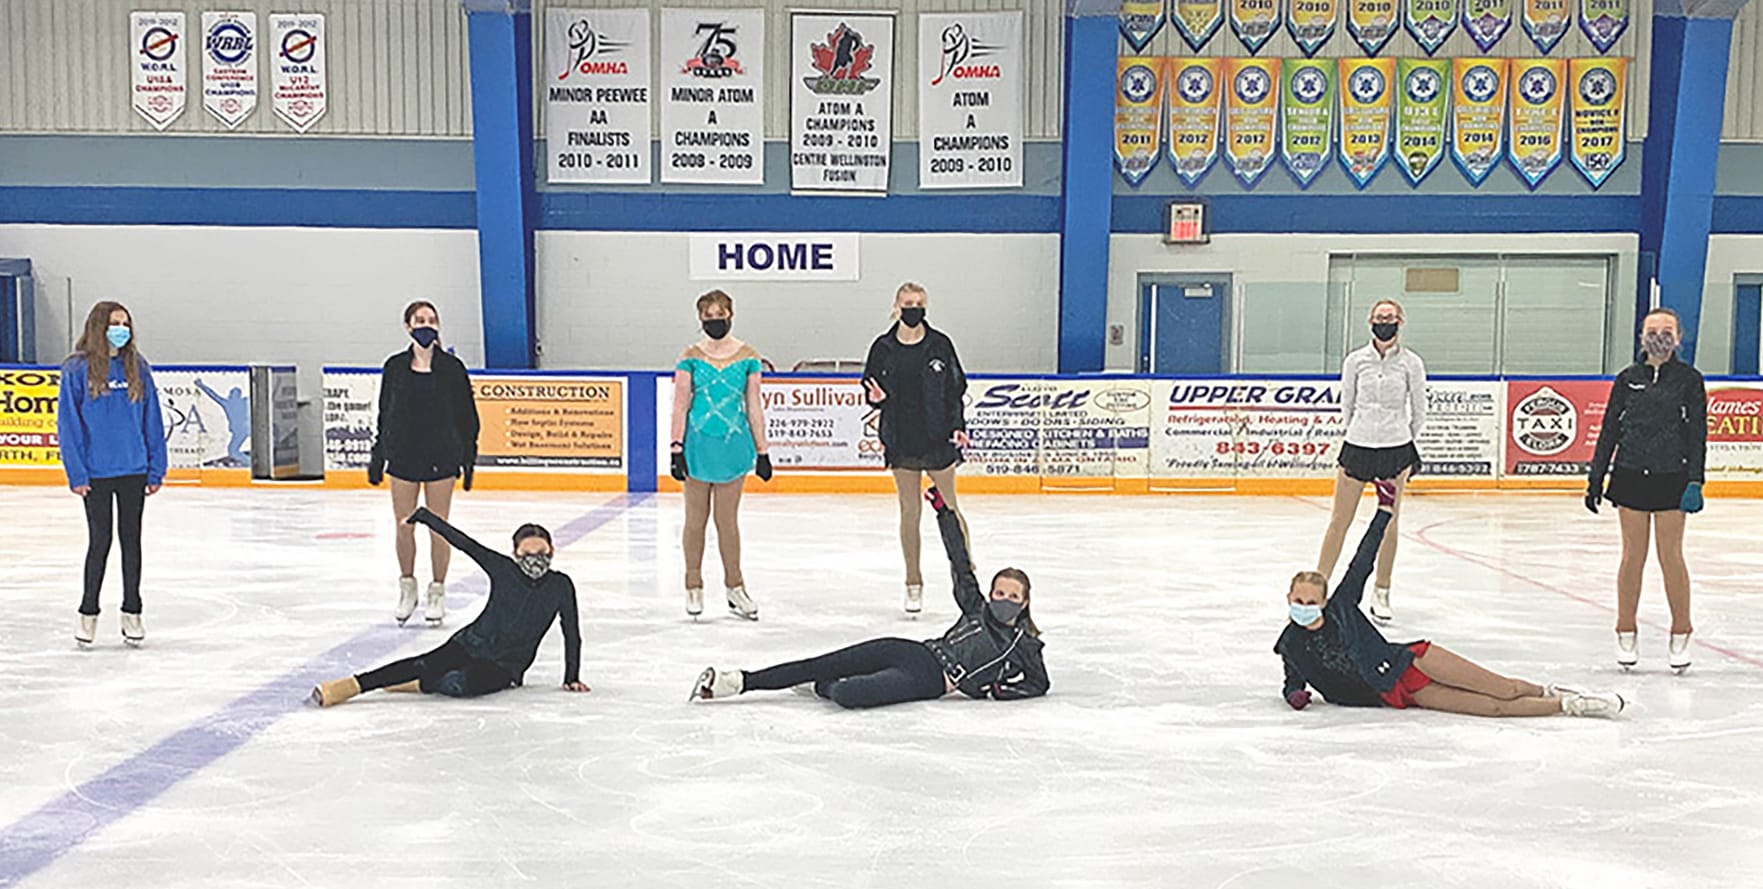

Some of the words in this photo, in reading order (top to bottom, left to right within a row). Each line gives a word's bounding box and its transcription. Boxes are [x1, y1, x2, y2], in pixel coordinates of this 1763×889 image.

[1297, 1, 1330, 12] 2010
[1358, 2, 1391, 12] 2010
[1416, 0, 1450, 11] 2010
[694, 22, 739, 58] 75
[580, 62, 628, 74] OMHA
[953, 66, 1001, 79] OMHA
[550, 87, 592, 102] MINOR
[596, 87, 647, 102] PEEWEE
[671, 87, 714, 102] MINOR
[718, 87, 754, 102] ATOM
[953, 92, 989, 107] ATOM
[817, 102, 851, 115] ATOM
[855, 102, 864, 115] A
[589, 110, 608, 124] AA
[707, 110, 717, 124] A
[966, 114, 976, 129] A
[805, 119, 875, 132] CHAMPIONS
[568, 132, 630, 146] FINALISTS
[675, 132, 750, 147] CHAMPIONS
[802, 134, 833, 147] 2009
[847, 135, 879, 148] 2010
[933, 136, 1009, 150] CHAMPIONS
[1121, 133, 1151, 144] 2011
[1179, 134, 1208, 144] 2012
[1236, 134, 1265, 144] 2012
[1292, 136, 1321, 145] 2012
[1404, 136, 1436, 147] 2014
[1581, 136, 1613, 147] 2017
[558, 154, 592, 168] 2010
[606, 154, 638, 168] 2011
[719, 154, 753, 168] 2009
[793, 154, 826, 167] CENTRE
[830, 154, 887, 167] WELLINGTON
[930, 158, 965, 173] 2009
[978, 157, 1012, 172] 2010
[823, 169, 857, 182] FUSION
[718, 243, 833, 270] HOME
[480, 384, 610, 398] CONSTRUCTION
[974, 384, 1091, 409] Scott
[1169, 386, 1267, 404] UPPER
[762, 391, 785, 409] yn
[510, 407, 551, 415] Additions
[1259, 415, 1308, 426] Heating
[1313, 415, 1323, 424] &
[1517, 418, 1573, 429] TAXI
[973, 430, 1035, 439] DESIGNED
[1096, 429, 1105, 438] &
[1165, 427, 1232, 436] Commercial
[1246, 427, 1303, 436] Industrial
[1215, 441, 1331, 456] 843-6397
